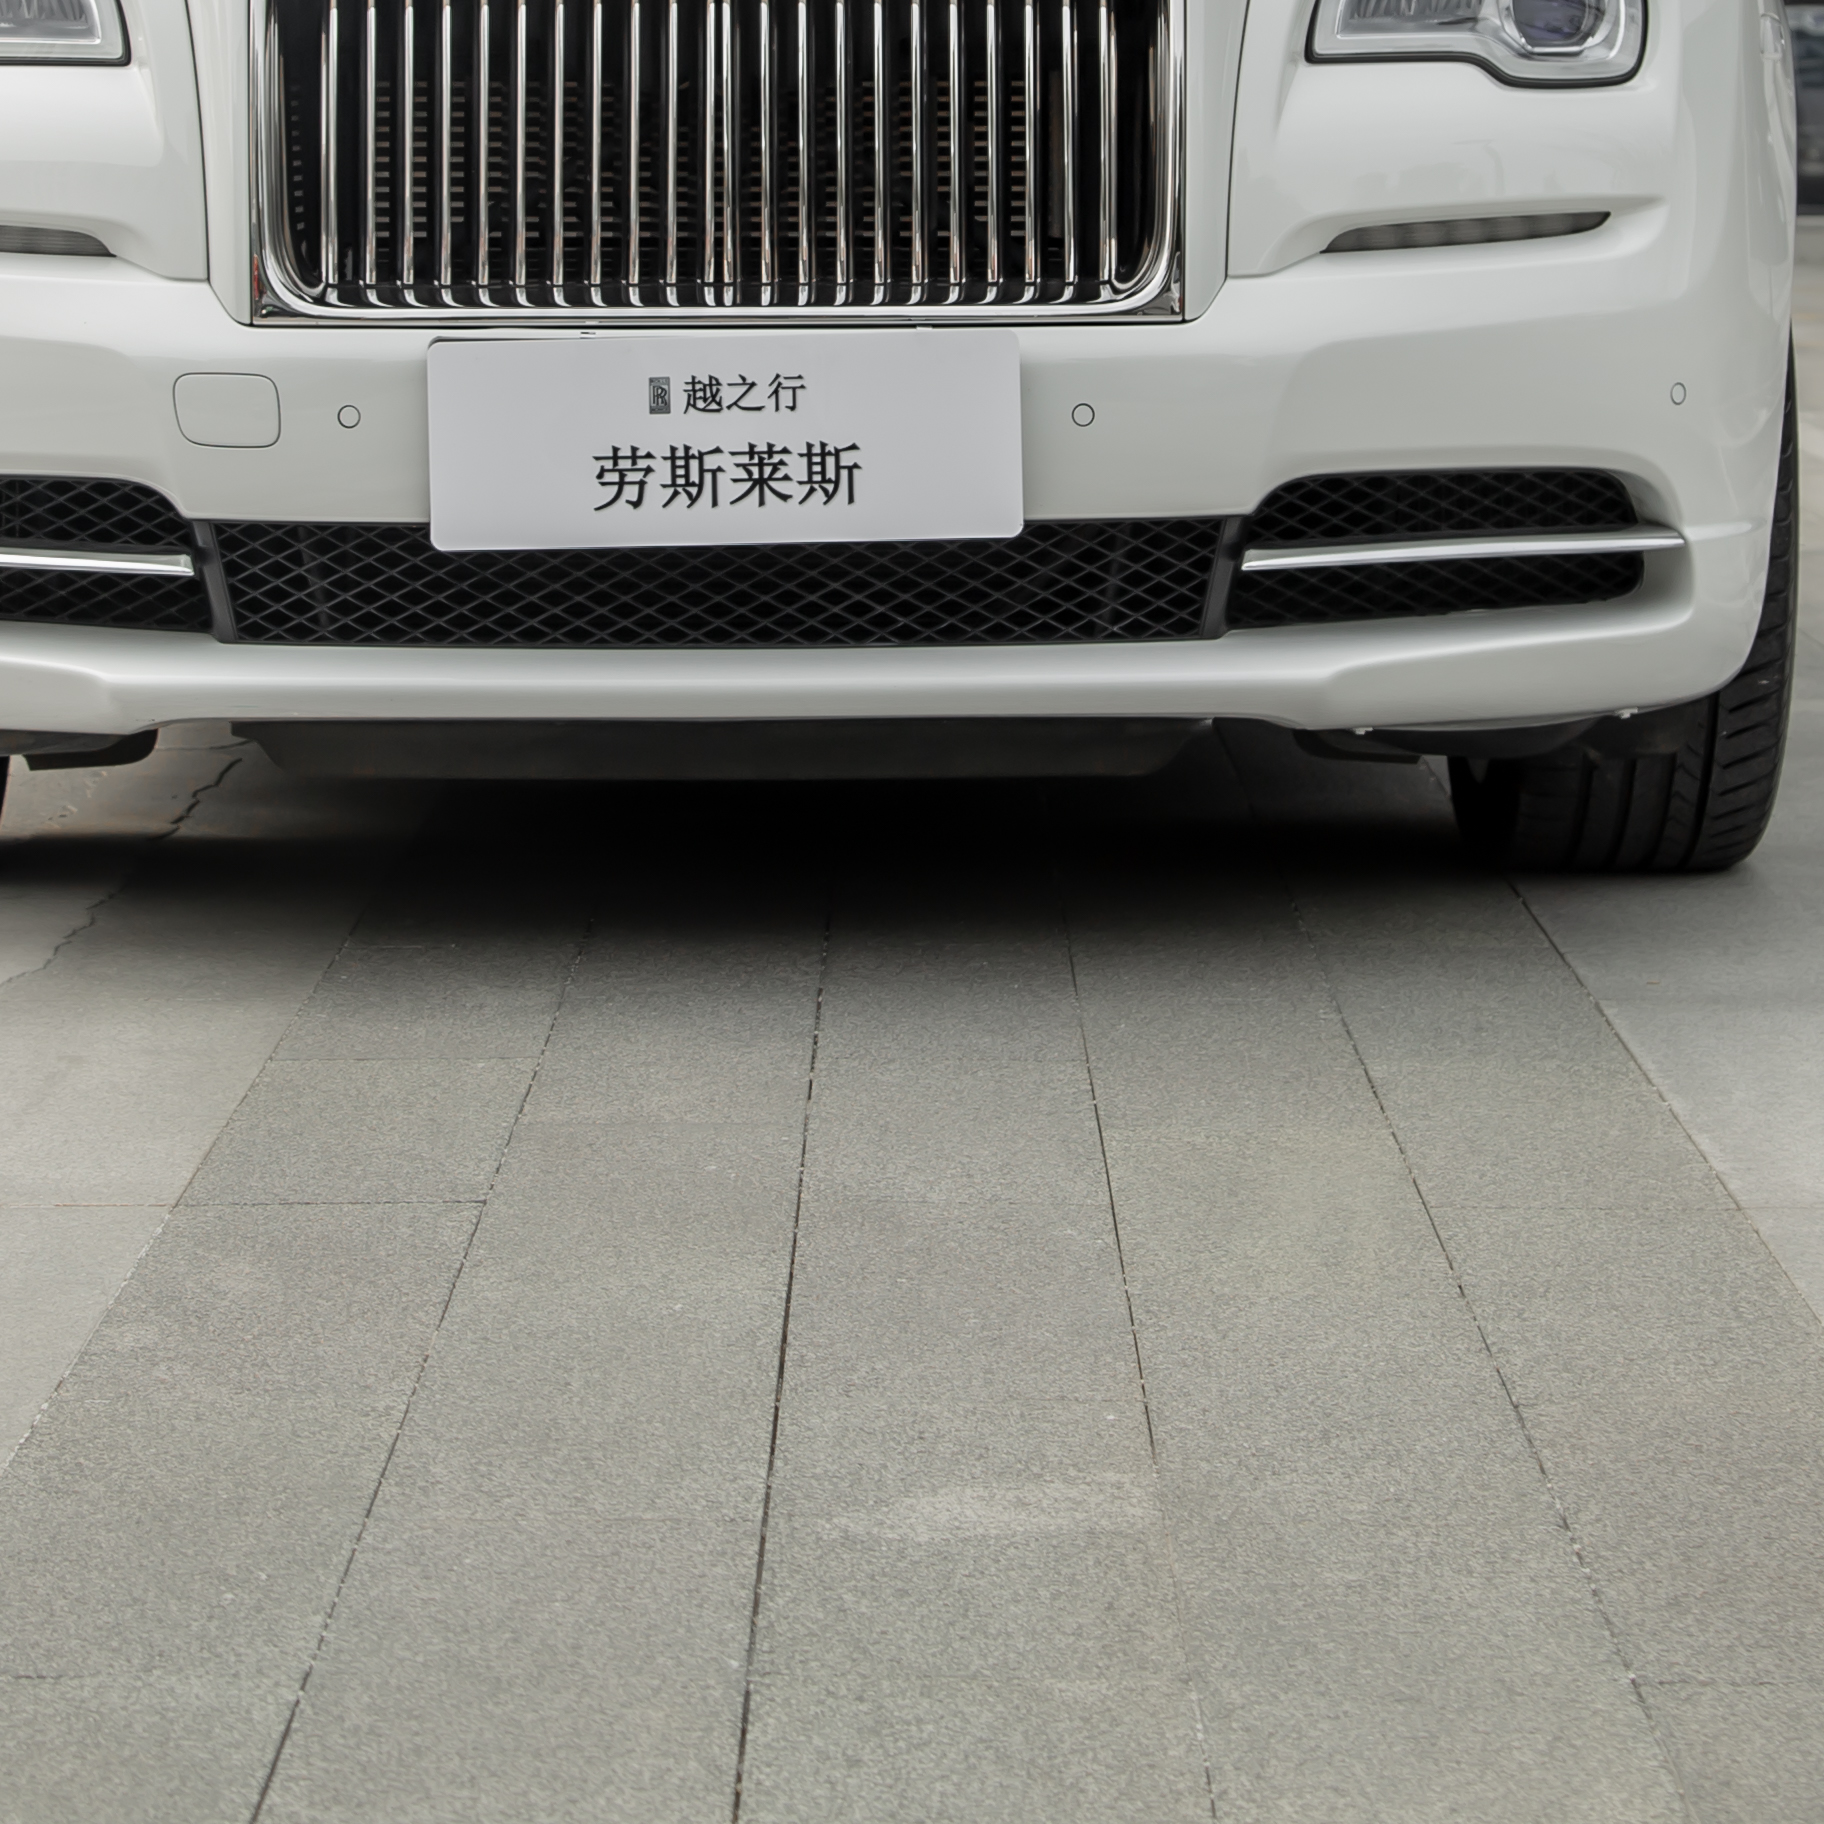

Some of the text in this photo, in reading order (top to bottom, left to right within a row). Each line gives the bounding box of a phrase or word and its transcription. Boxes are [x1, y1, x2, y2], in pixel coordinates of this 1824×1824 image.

[682, 372, 807, 415] 越之行
[591, 440, 863, 512] 劳斯莱斯
